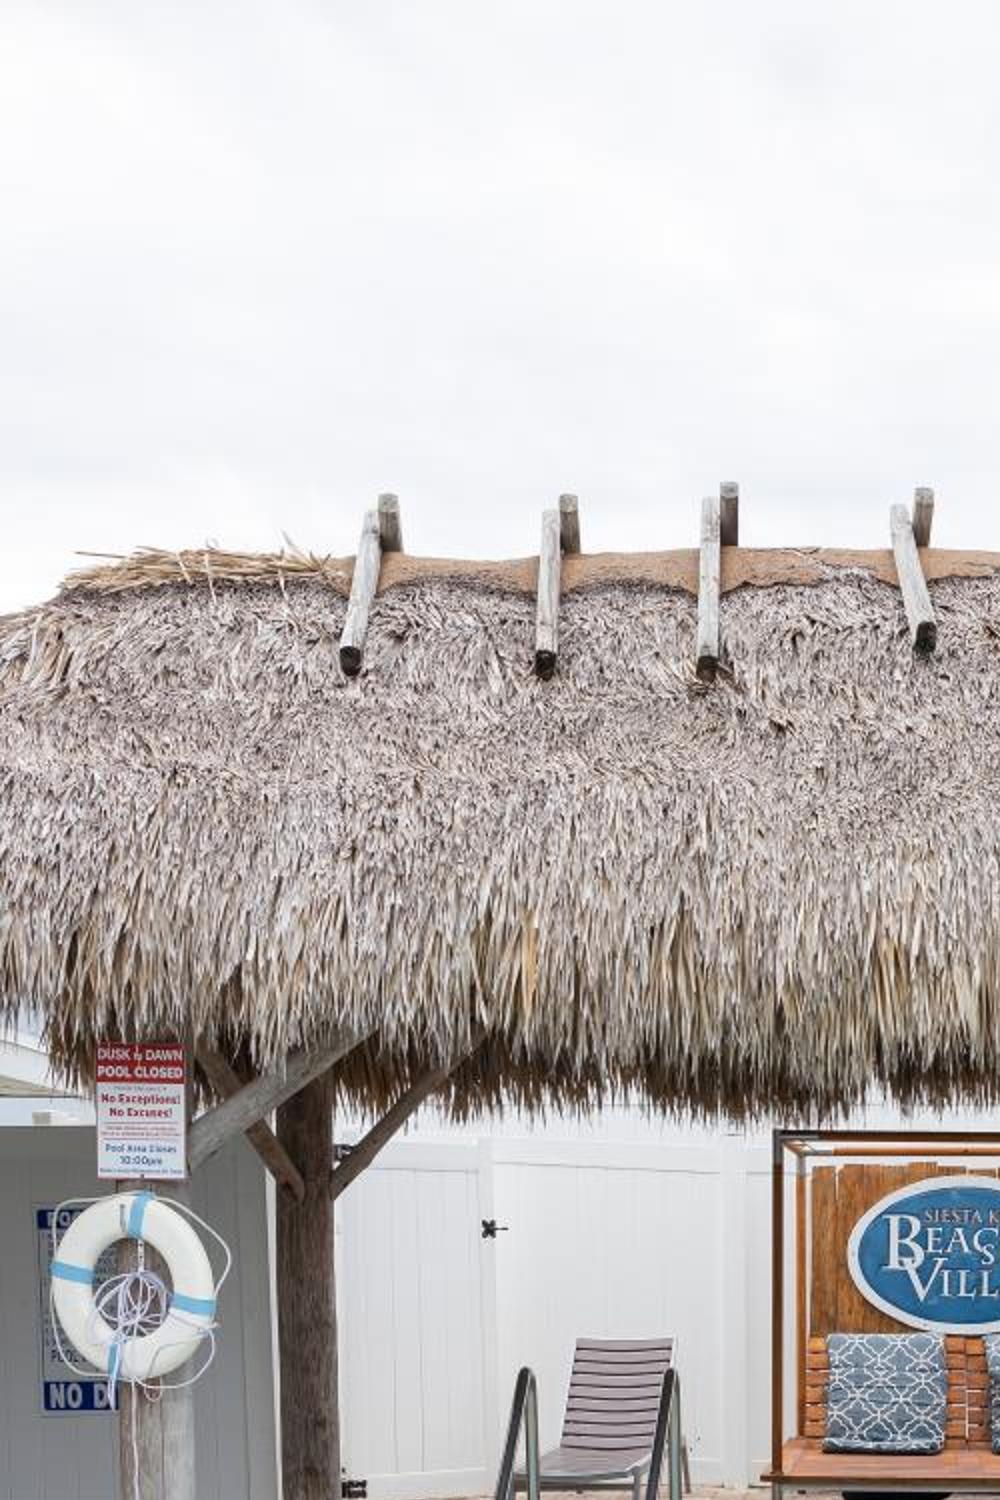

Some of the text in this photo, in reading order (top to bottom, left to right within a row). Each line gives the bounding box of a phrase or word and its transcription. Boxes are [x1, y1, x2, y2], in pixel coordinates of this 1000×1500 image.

[98, 1047, 130, 1060] DUSK
[145, 1049, 182, 1061] DAWN
[97, 1065, 183, 1079] POOL CLOSED
[101, 1093, 181, 1106] No Exceptions!
[109, 1107, 172, 1118] No Excuses!
[924, 1209, 982, 1223] SIESTA
[50, 1383, 82, 1408] NO
